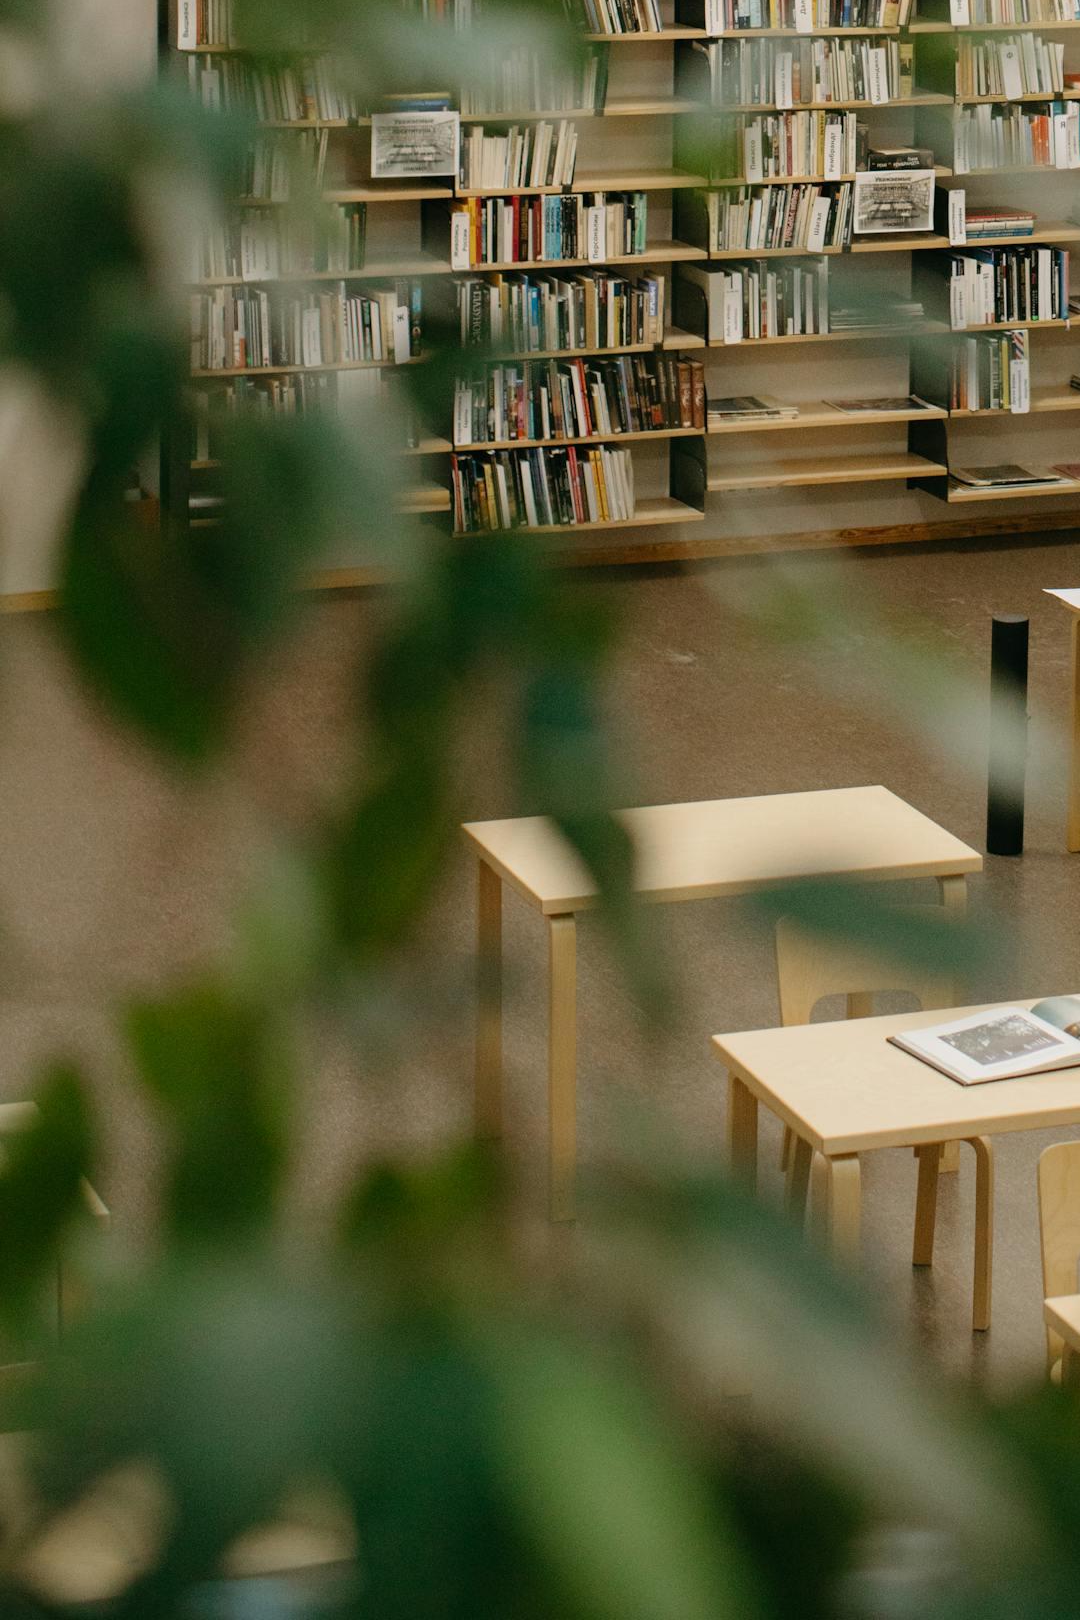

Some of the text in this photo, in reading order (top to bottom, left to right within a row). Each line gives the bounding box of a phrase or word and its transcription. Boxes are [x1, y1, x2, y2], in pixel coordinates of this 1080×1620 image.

[182, 1, 190, 38] Вышивка
[874, 51, 882, 102] Микеланджело
[1060, 120, 1066, 129] Я
[813, 212, 823, 236] Шагал
[396, 313, 404, 322] Ж
